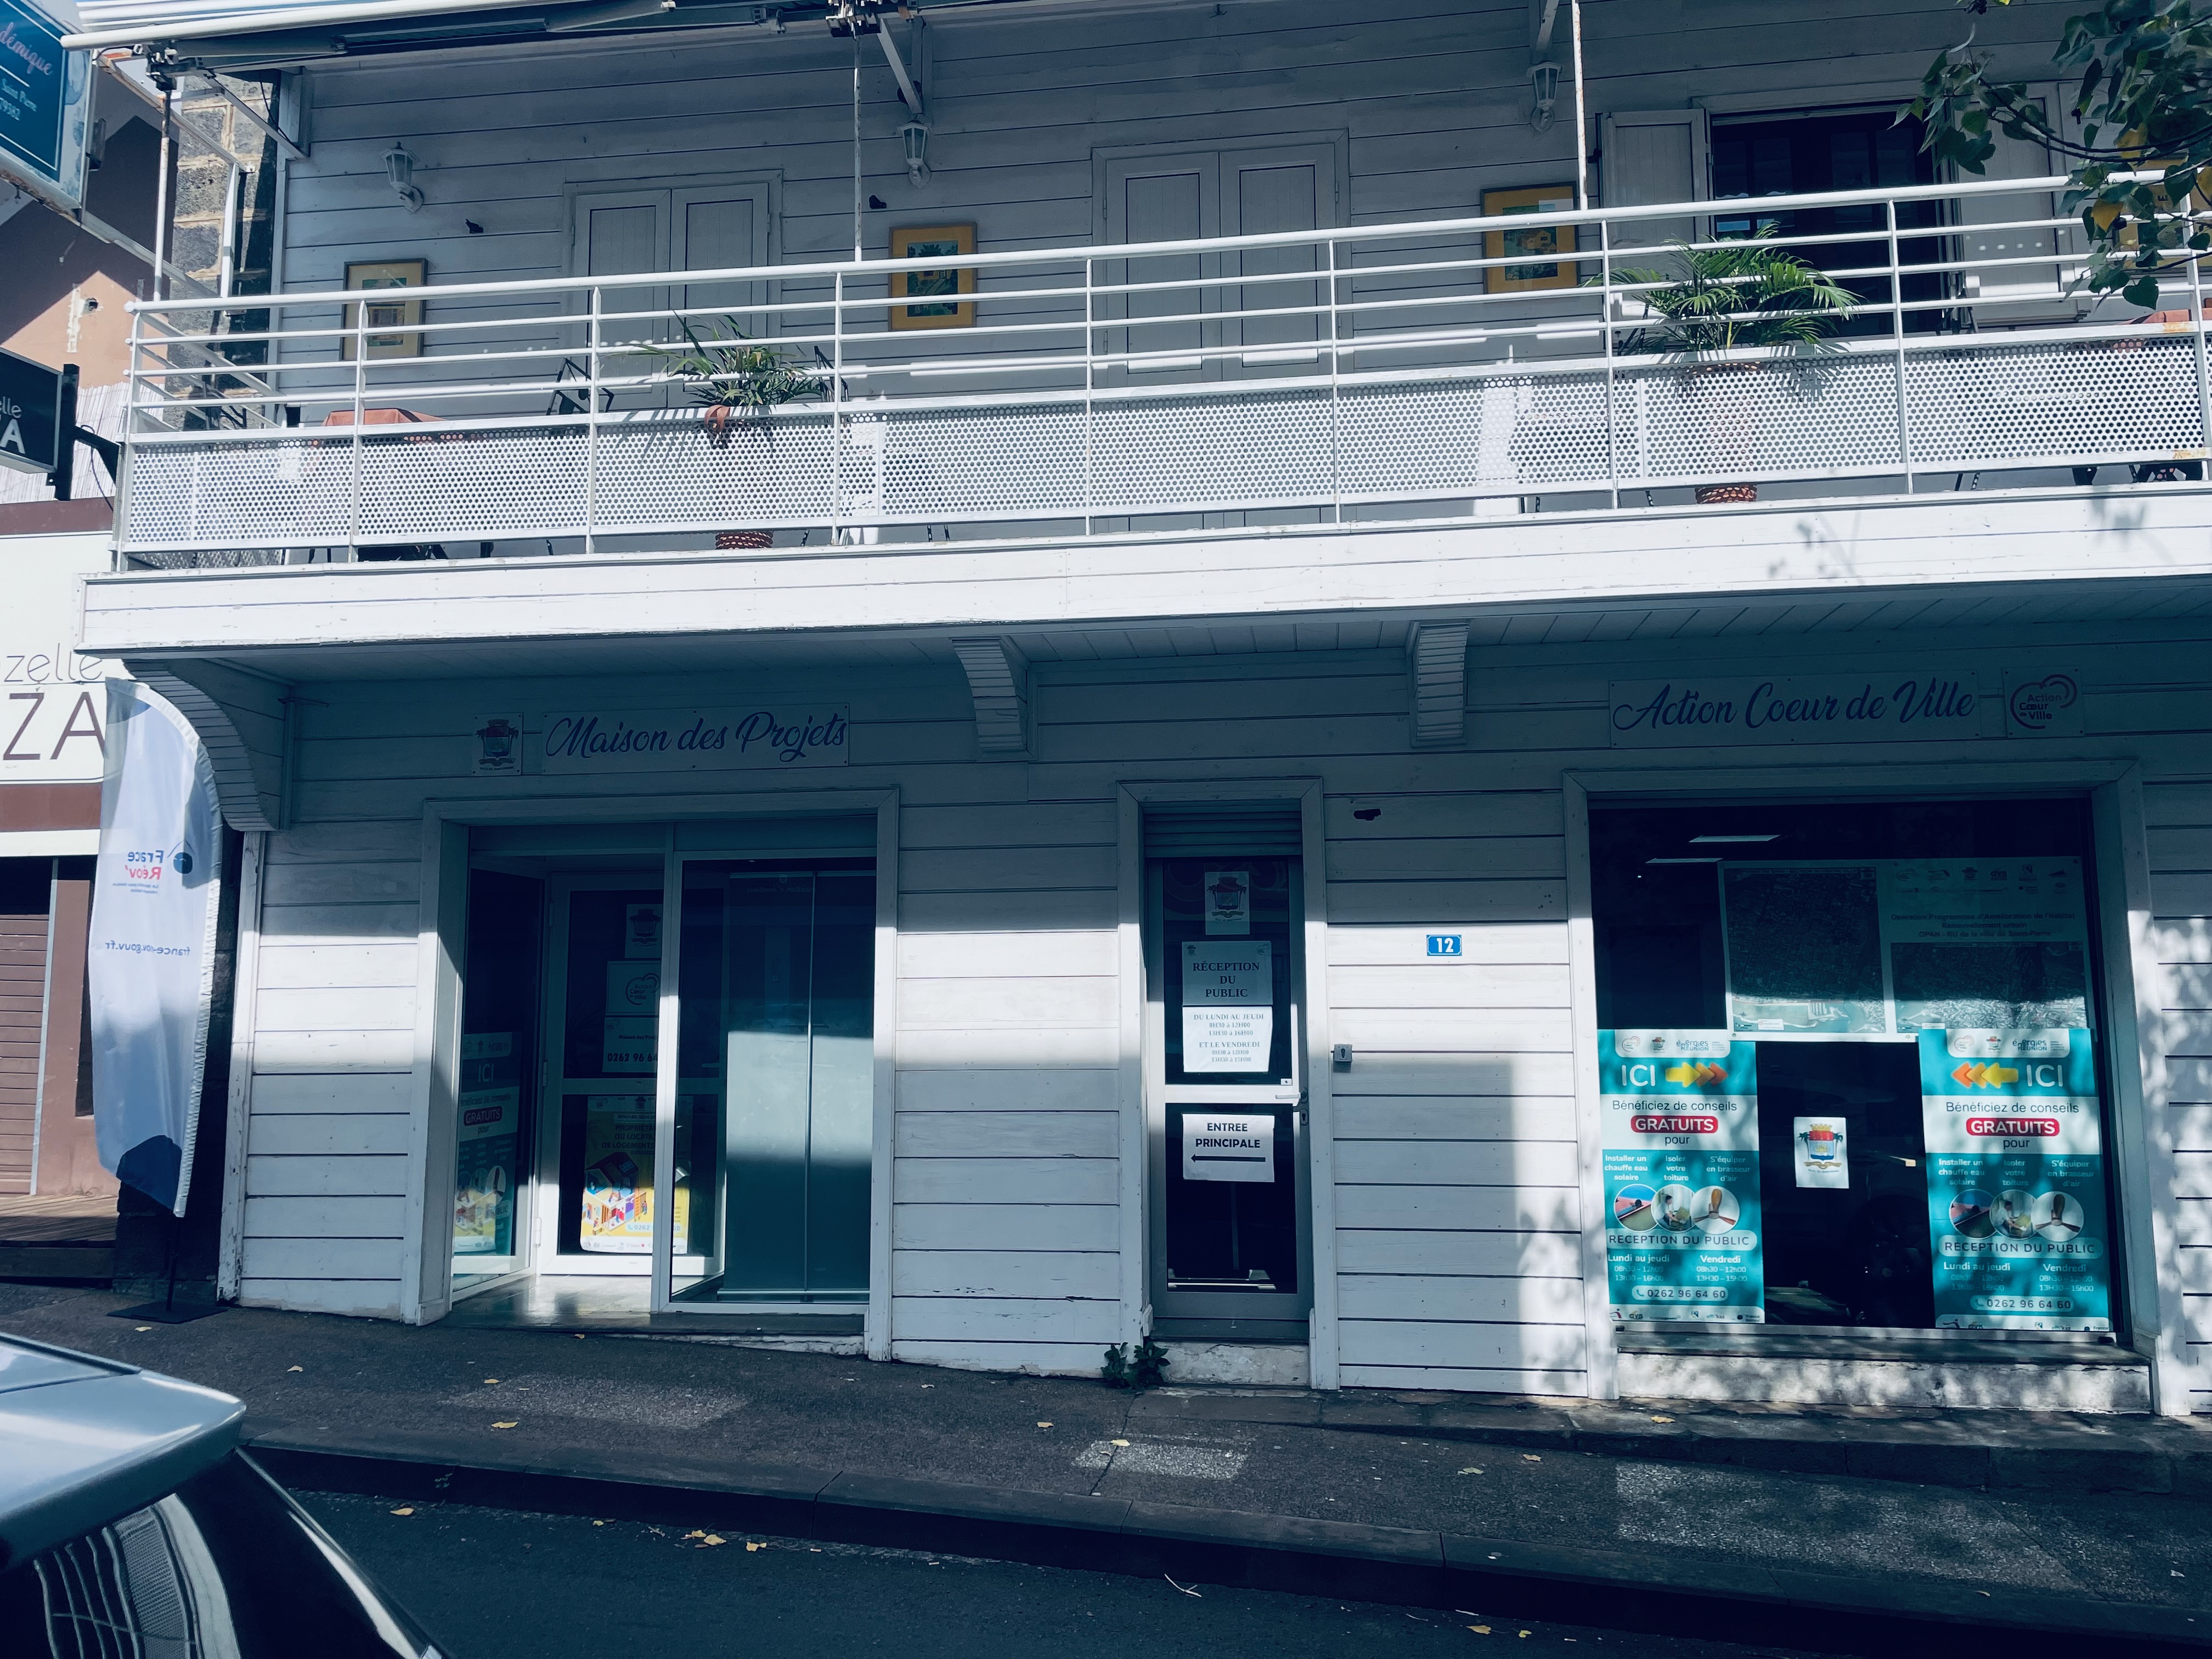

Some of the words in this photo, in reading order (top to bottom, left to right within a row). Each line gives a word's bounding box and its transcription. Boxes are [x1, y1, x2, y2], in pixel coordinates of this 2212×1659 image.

[0, 419, 26, 454] A
[0, 642, 103, 681] zelle
[2027, 693, 2062, 702] Action
[1613, 683, 1737, 730] Action
[1746, 682, 1840, 729] Coeur
[1846, 684, 1887, 720] de
[1893, 677, 1975, 723] Ville
[2029, 711, 2052, 720] Ville
[3, 691, 105, 760] ZA
[545, 716, 673, 759] Maison
[678, 718, 728, 751] des
[735, 711, 847, 762] Projets
[1436, 938, 1454, 952] 12
[1193, 961, 1260, 972] RÉCEPTION
[1220, 976, 1235, 984] DU
[1205, 989, 1248, 997] PUBLIC
[607, 1053, 630, 1062] 0262
[633, 1053, 644, 1062] 96
[478, 1063, 494, 1083] ICI
[1621, 1064, 1656, 1087] ICI
[2026, 1064, 2063, 1087] ICI
[1613, 1100, 1670, 1110] Bénéficiez
[1674, 1100, 1687, 1110] de
[1691, 1101, 1737, 1111] conseils
[1946, 1102, 2007, 1113] Bénéficiez
[2011, 1102, 2027, 1113] de
[2030, 1102, 2079, 1113] conseils
[466, 1109, 500, 1124] GRATUITS
[1207, 1123, 1248, 1132] ENTREE
[1635, 1118, 1714, 1131] GRATUITS
[1971, 1120, 2056, 1134] GRATUITS
[1195, 1138, 1260, 1148] PRINCIPALE
[1664, 1136, 1690, 1147] pour
[2003, 1138, 2030, 1150] pour
[2051, 1160, 2090, 1169] S'équiper
[1609, 1234, 1678, 1245] RECEPTION
[1683, 1235, 1700, 1244] DU
[1705, 1235, 1750, 1245] PUBLIC
[1945, 1242, 2018, 1252] RECEPTION
[2024, 1244, 2041, 1252] DU
[2048, 1244, 2095, 1254] PUBLIC
[1607, 1254, 1632, 1262] Lundi
[1647, 1254, 1670, 1265] jeudi
[1700, 1255, 1741, 1263] Vendredi
[1944, 1262, 1970, 1270] Lundi
[1987, 1262, 2011, 1272] jeudi
[2043, 1264, 2086, 1272] Vendredi
[1647, 1289, 1674, 1298] 0262
[1678, 1290, 1691, 1298] 96
[1695, 1290, 1708, 1298] 64
[1713, 1290, 1726, 1298] 60
[1987, 1299, 2015, 1308] 0262
[2020, 1300, 2033, 1308] 96
[2039, 1300, 2052, 1308] 64
[2057, 1300, 2071, 1309] 60
